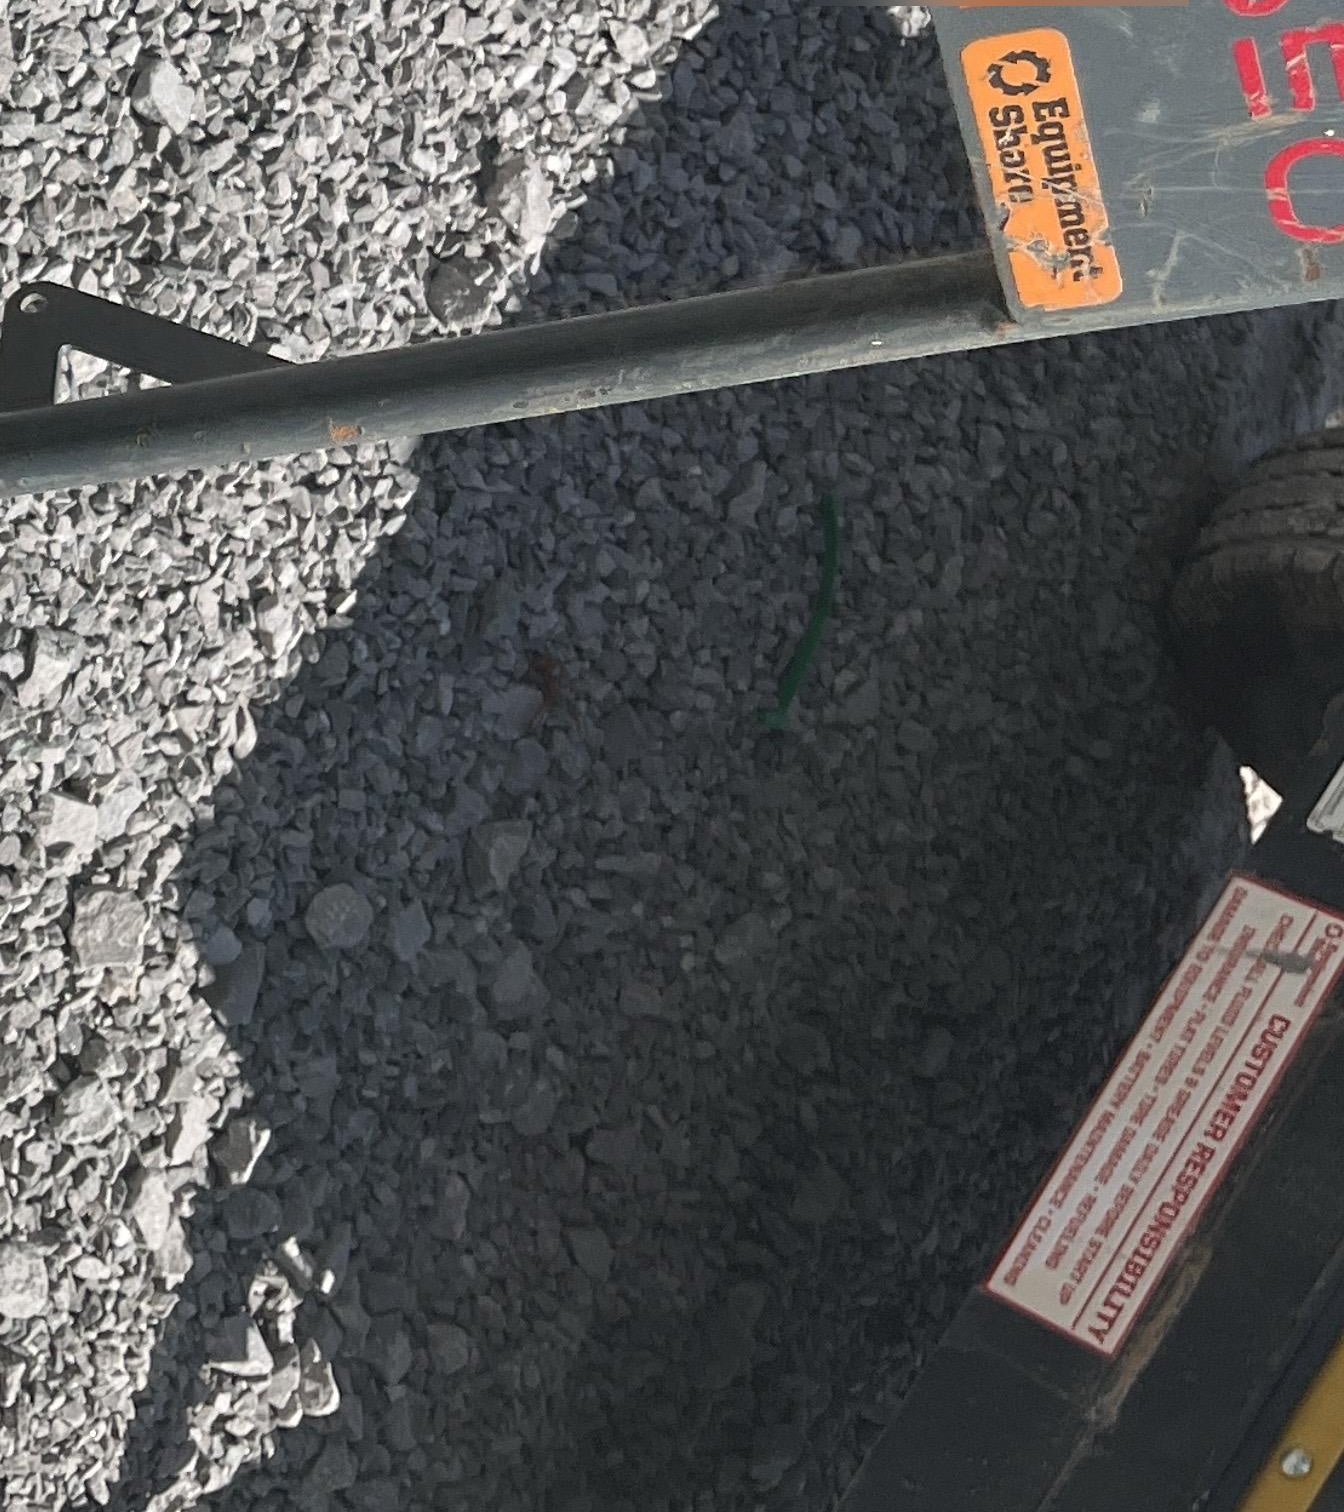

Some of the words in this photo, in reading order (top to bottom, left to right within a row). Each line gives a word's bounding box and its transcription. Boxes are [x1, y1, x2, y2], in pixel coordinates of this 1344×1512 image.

[989, 103, 1035, 204] Share
[1030, 96, 1104, 283] Equipment
[1258, 912, 1294, 960] CHEC
[1203, 1012, 1292, 1144] CUSTOMER
[1084, 1140, 1216, 1345] RESPONSIBILITY
